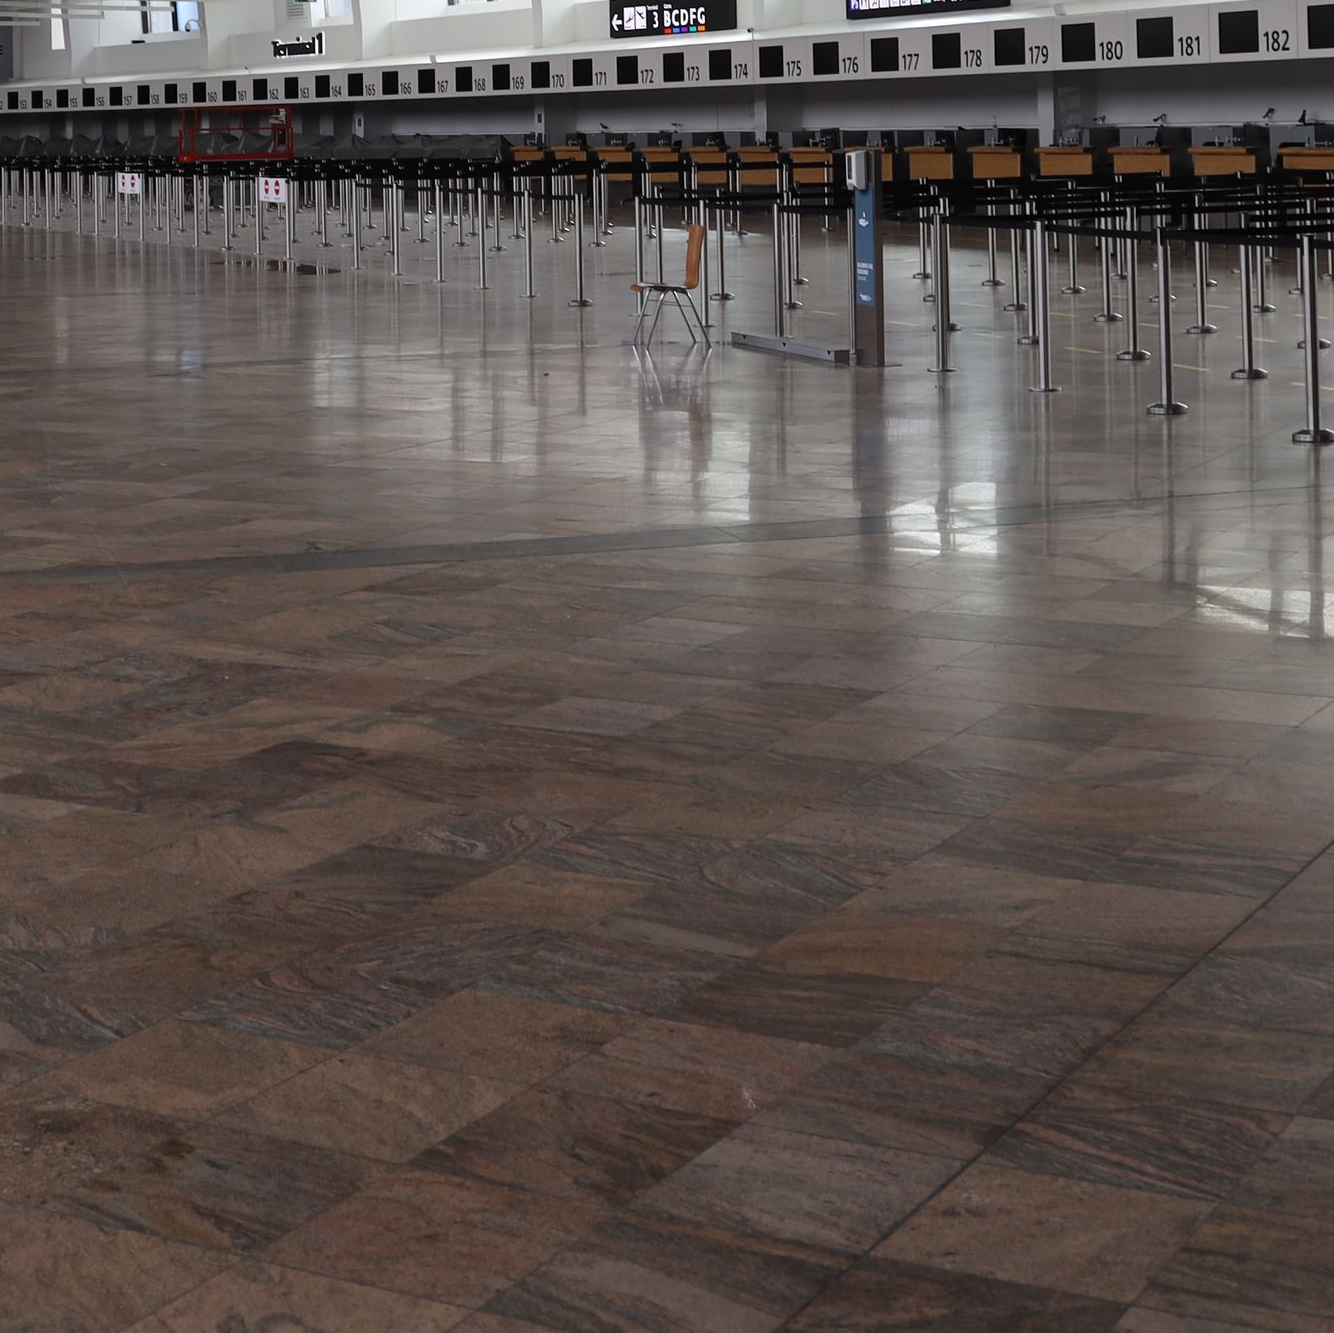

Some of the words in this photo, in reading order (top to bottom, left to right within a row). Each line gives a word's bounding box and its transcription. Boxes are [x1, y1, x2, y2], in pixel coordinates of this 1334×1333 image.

[653, 12, 659, 28] 3
[1178, 36, 1200, 56] 181
[1264, 30, 1290, 52] 182
[1029, 45, 1048, 64] 179
[1099, 41, 1123, 60] 180
[842, 57, 858, 73] 176
[902, 54, 919, 70] 177
[964, 50, 982, 67] 178
[687, 66, 699, 81] 173
[734, 64, 748, 79] 174
[787, 61, 801, 76] 175
[512, 76, 524, 89] 169
[552, 74, 564, 87] 170
[595, 72, 606, 85] 171
[641, 69, 654, 83] 172
[365, 84, 375, 96] 165
[400, 82, 411, 95] 166
[437, 80, 448, 93] 167
[474, 78, 486, 91] 168
[179, 93, 187, 103] 159
[208, 92, 217, 102] 160
[238, 90, 247, 101] 161
[269, 89, 278, 100] 162
[300, 87, 309, 99] 163
[331, 86, 341, 98] 164
[69, 98, 78, 108] 155
[96, 96, 105, 107] 156
[124, 95, 132, 106] 157
[151, 94, 159, 104] 158
